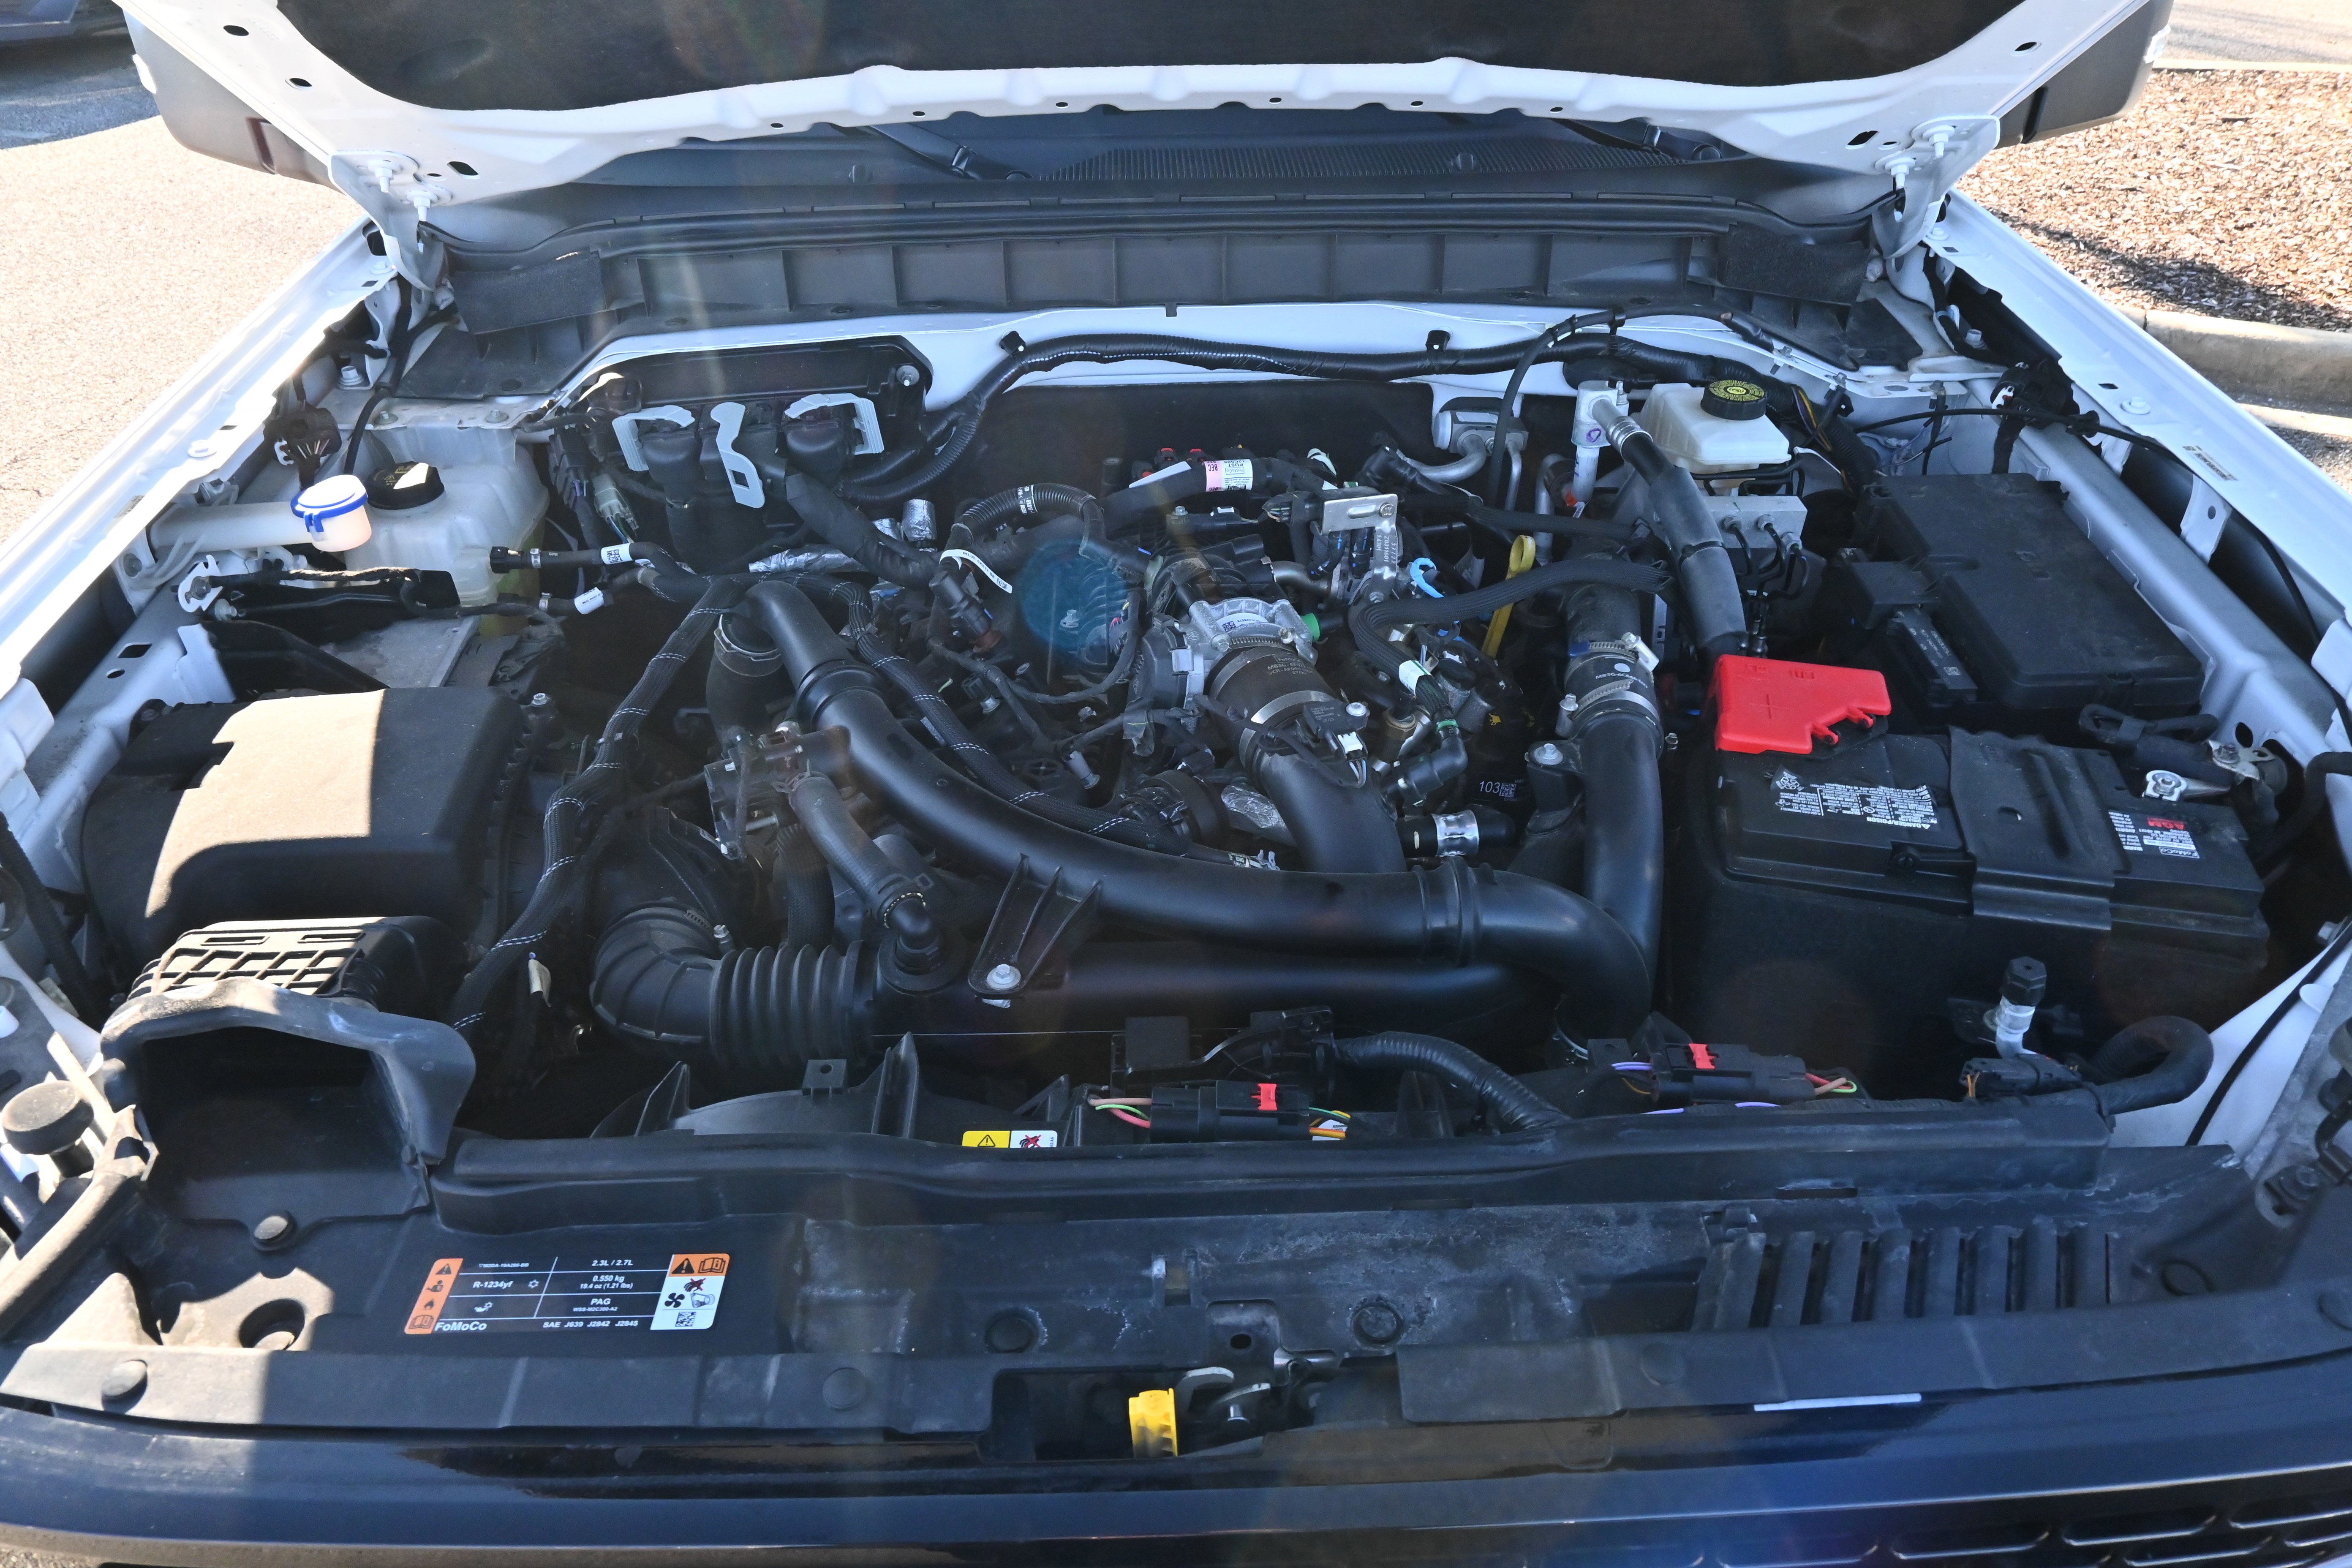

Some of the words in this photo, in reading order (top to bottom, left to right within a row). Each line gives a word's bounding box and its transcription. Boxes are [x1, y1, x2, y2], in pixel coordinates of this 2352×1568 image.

[1479, 781, 1500, 793] 103
[1866, 817, 1922, 828] DANGER/POISON
[615, 1275, 625, 1283] kg
[472, 1280, 514, 1289] R-1234yf
[434, 1321, 487, 1331] FoMoCo
